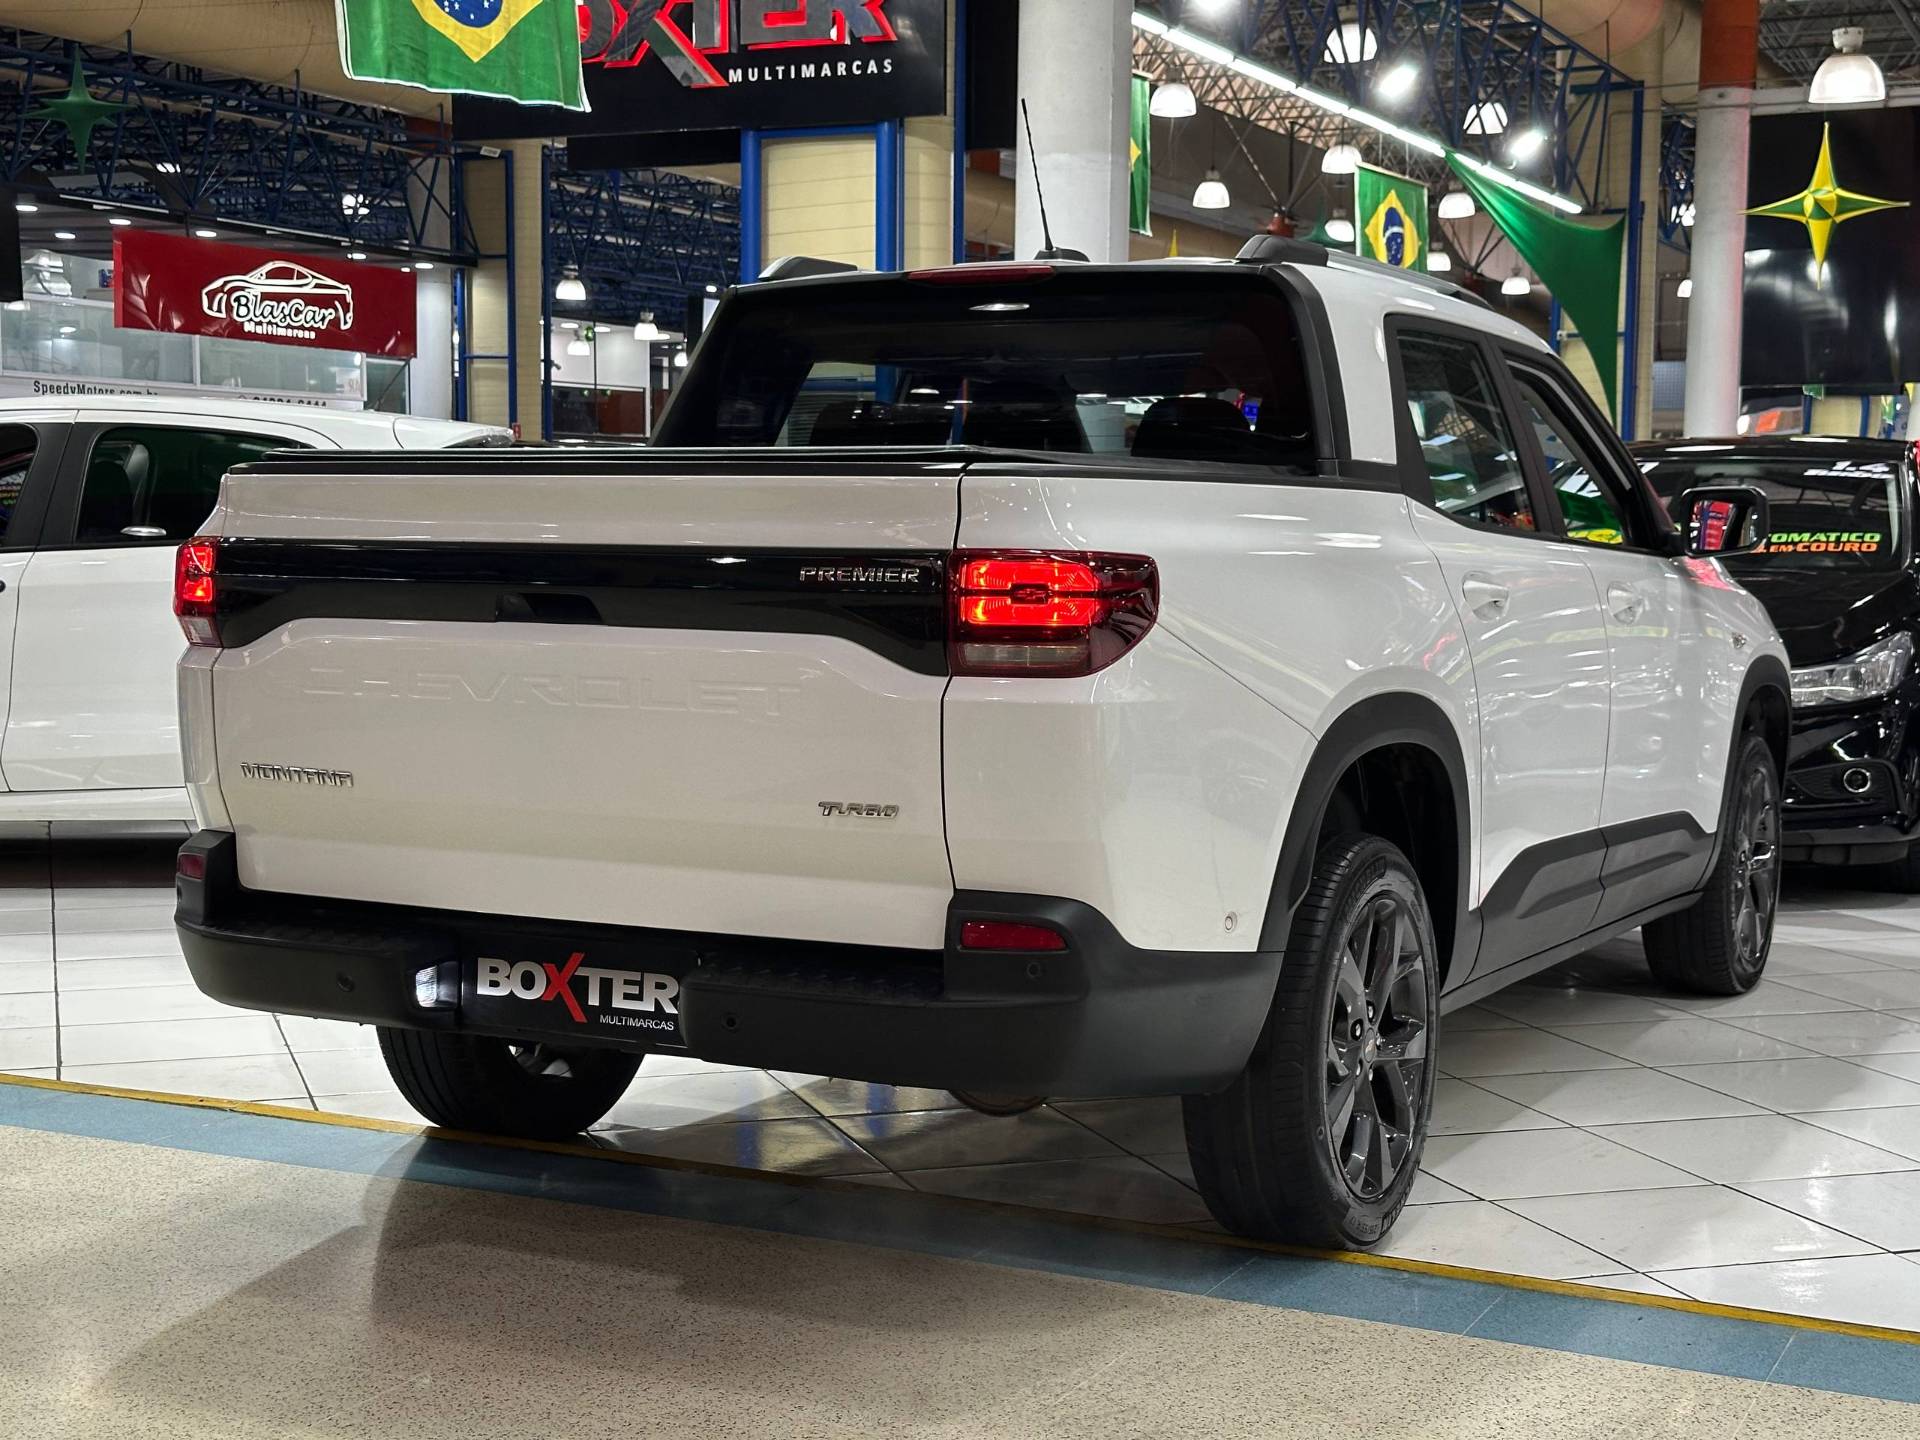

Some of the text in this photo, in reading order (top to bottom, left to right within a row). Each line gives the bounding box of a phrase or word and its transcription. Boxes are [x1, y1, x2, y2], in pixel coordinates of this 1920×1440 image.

[728, 58, 893, 83] MULTIMARCAS
[230, 290, 336, 330] BlasCar
[1795, 542, 1878, 553] COURO
[800, 567, 920, 583] PREMIER
[302, 666, 802, 717] CHEVROLET
[240, 762, 354, 787] MONTANA
[818, 801, 899, 819] TURBO
[476, 952, 679, 1023] BOXTER
[600, 1014, 675, 1031] MULTIMARCAS
